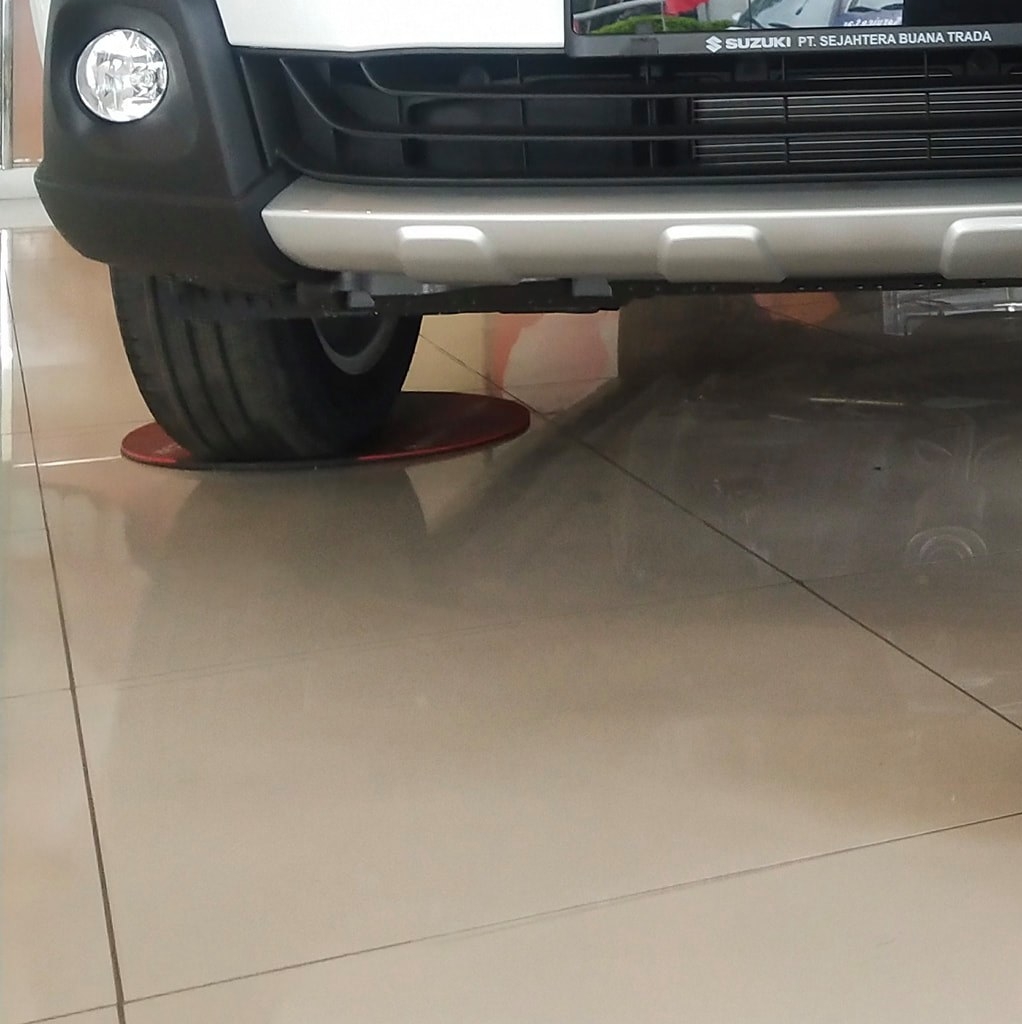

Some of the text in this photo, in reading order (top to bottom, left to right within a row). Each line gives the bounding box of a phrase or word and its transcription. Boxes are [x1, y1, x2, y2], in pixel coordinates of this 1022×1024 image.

[725, 31, 992, 49] SUZUKI PT. SEJAHTERA BUANA TRADA
